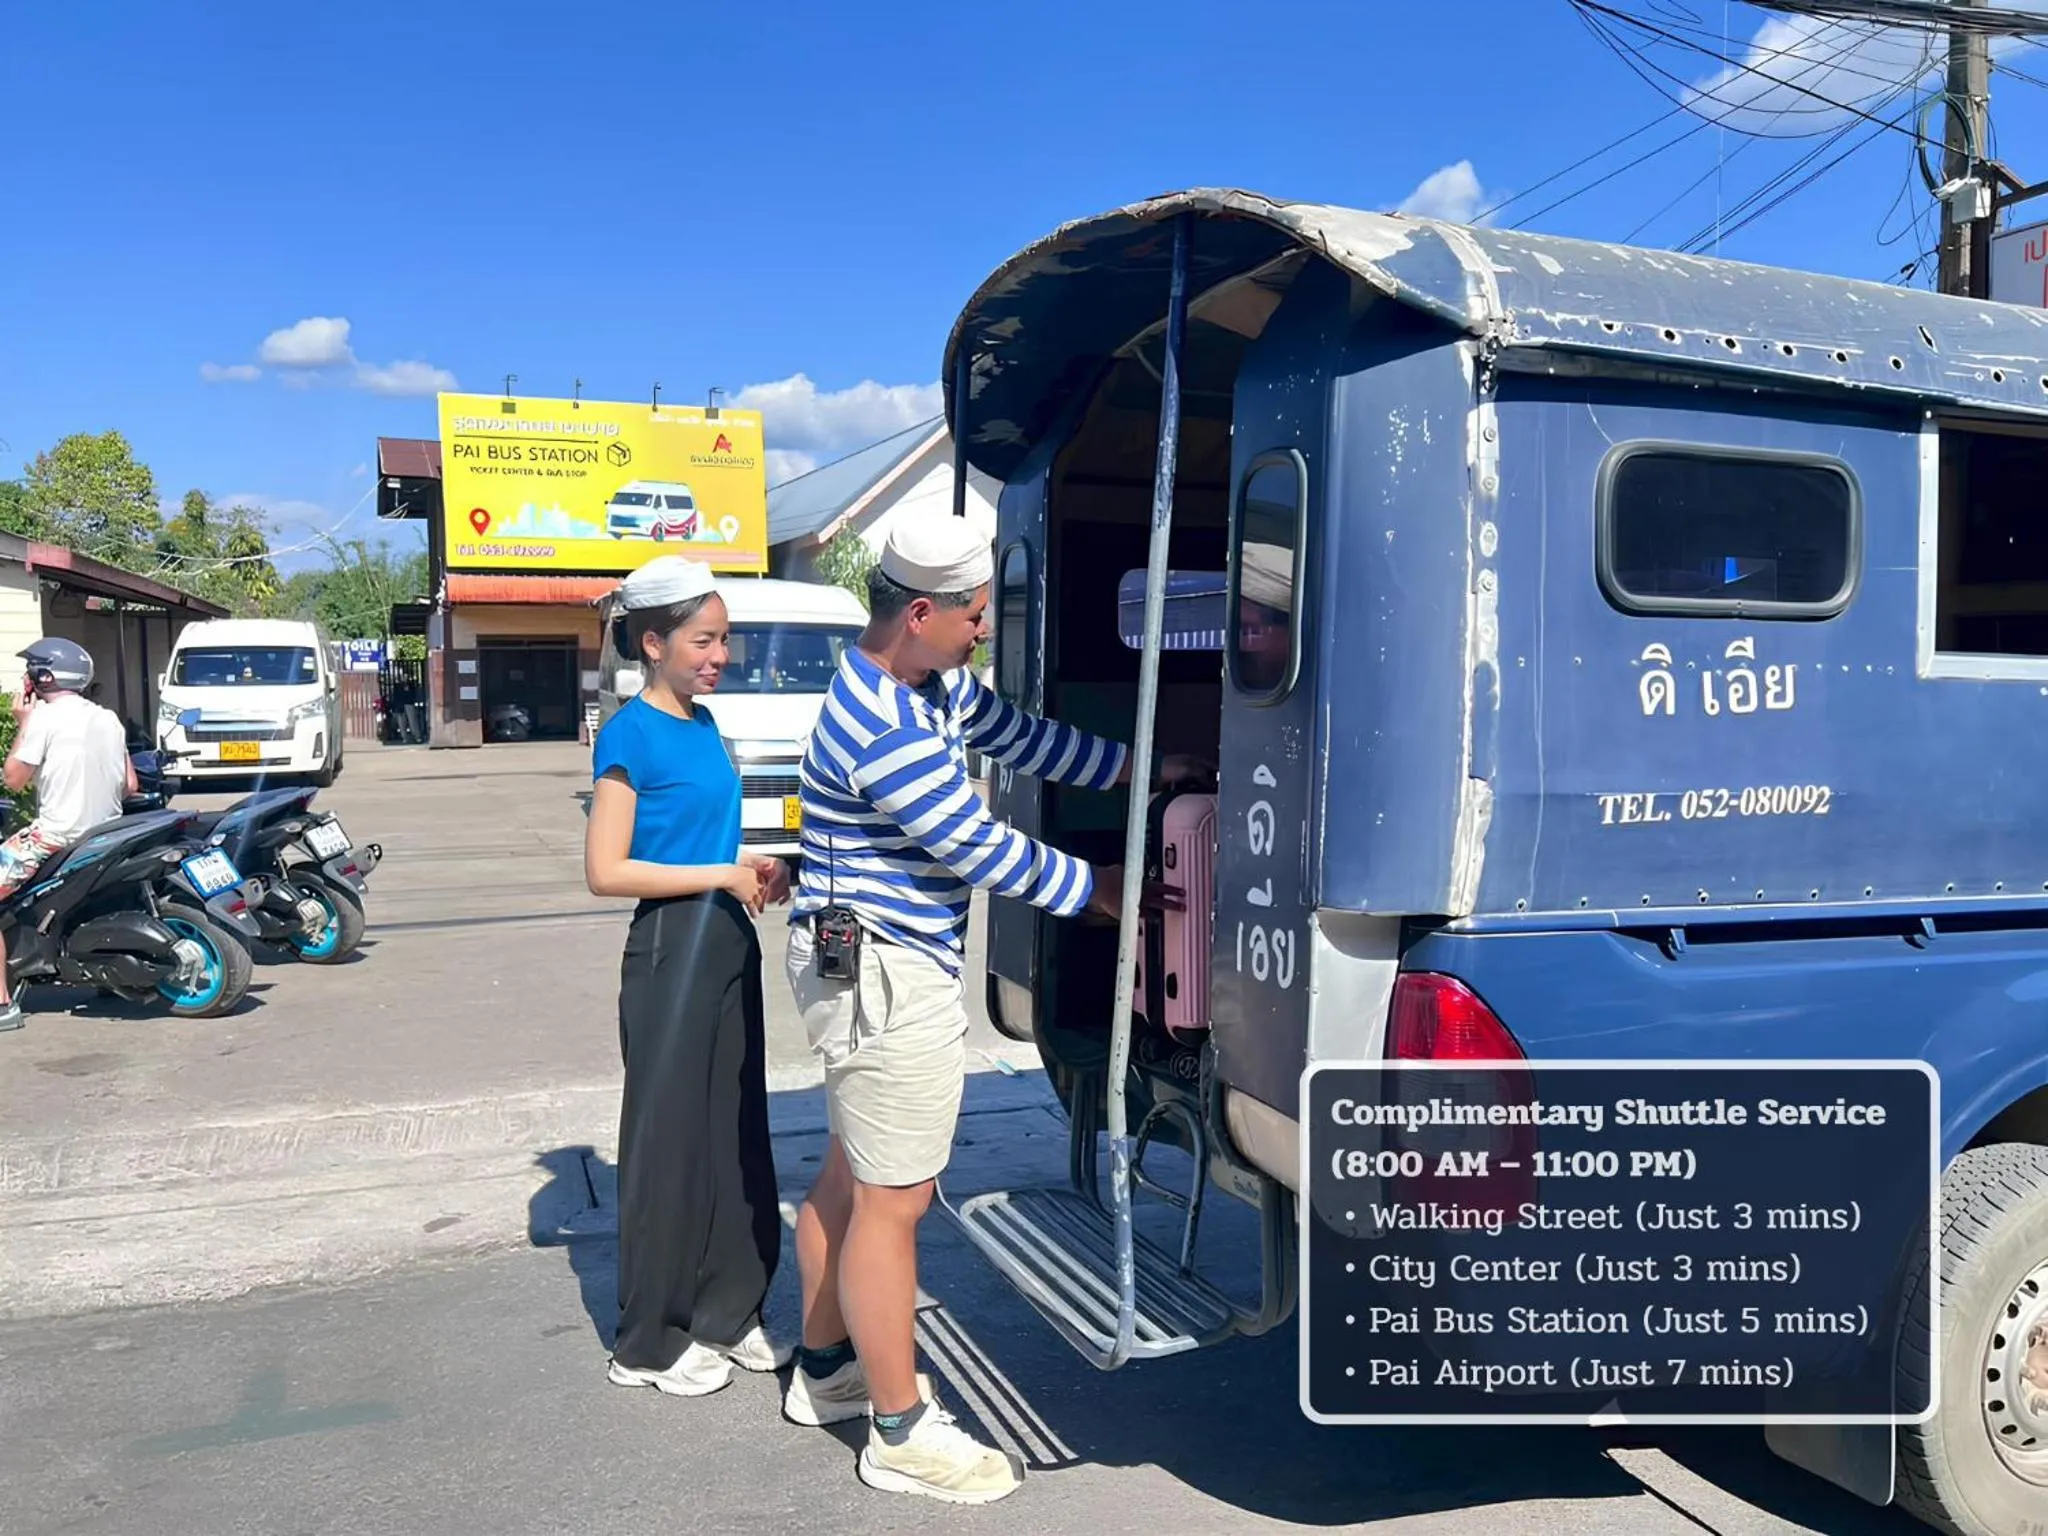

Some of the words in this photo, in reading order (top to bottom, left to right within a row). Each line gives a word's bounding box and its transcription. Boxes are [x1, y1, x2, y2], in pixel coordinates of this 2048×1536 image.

[453, 443, 481, 459] PAI
[488, 445, 522, 460] BUS
[528, 447, 599, 463] STATION
[1598, 791, 1673, 825] TEL.
[1680, 784, 1832, 821] 052-080092
